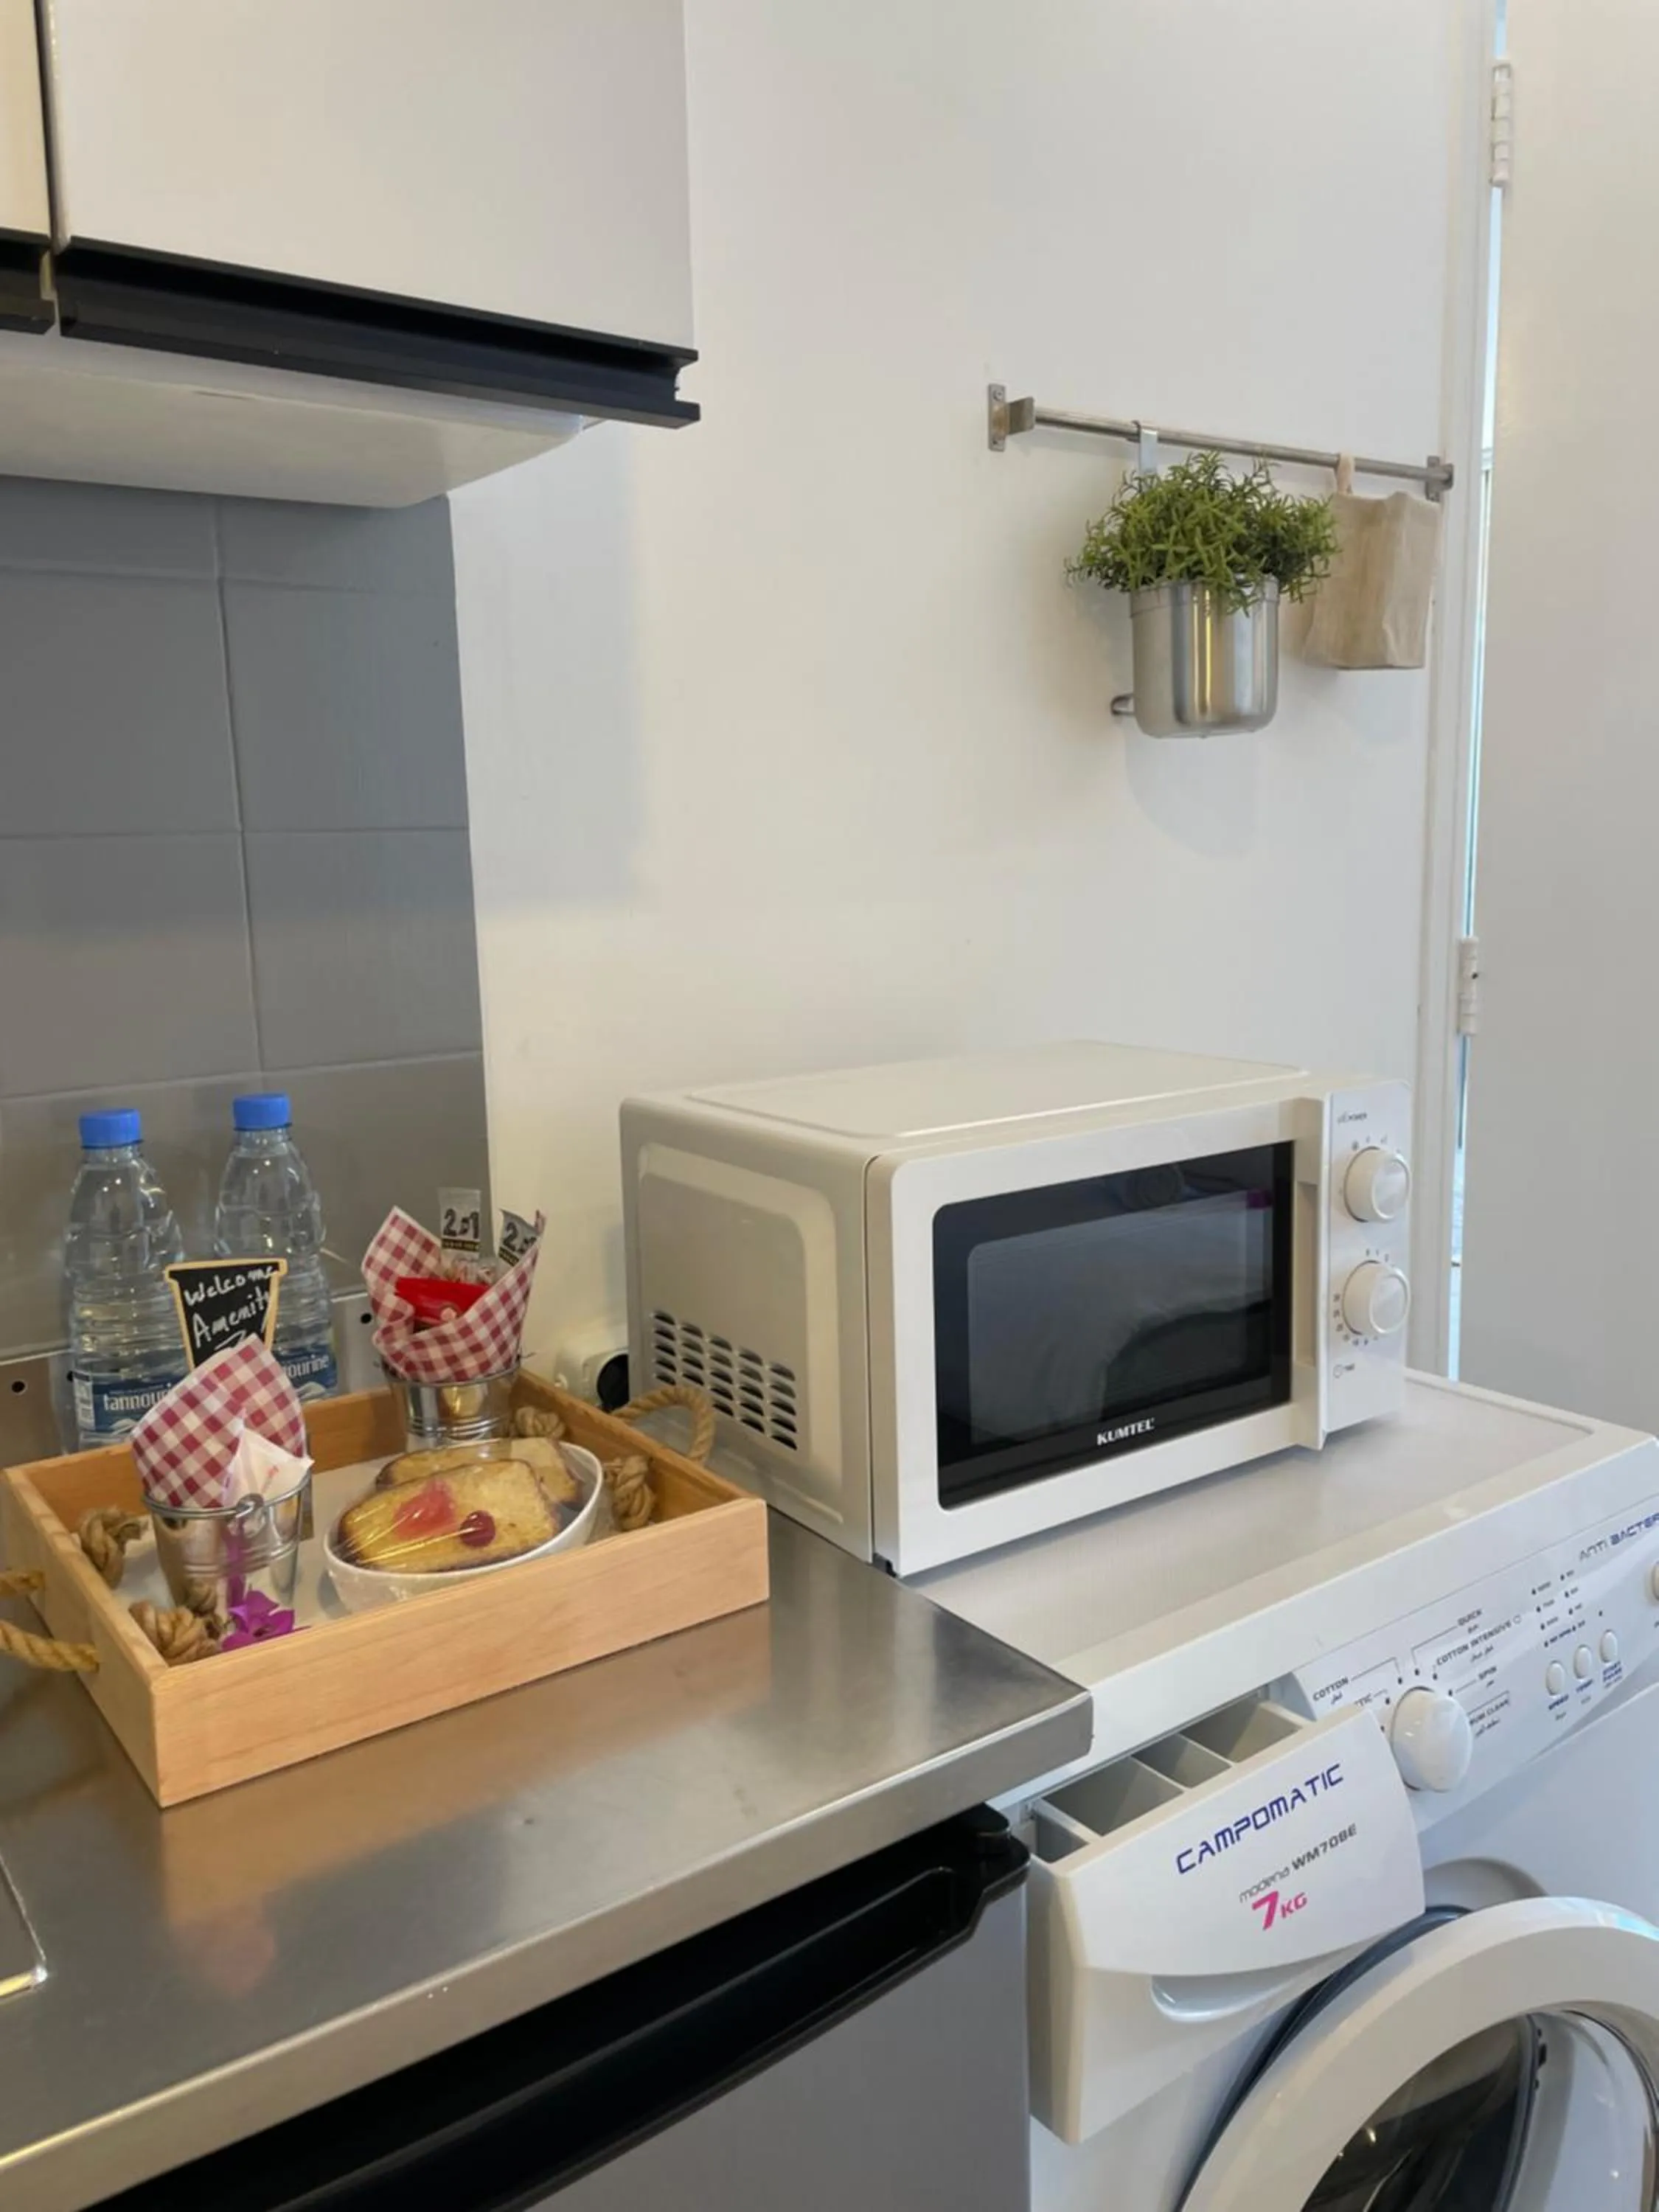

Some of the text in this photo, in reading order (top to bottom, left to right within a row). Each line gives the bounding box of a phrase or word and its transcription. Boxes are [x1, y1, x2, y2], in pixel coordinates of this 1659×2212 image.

[184, 1266, 277, 1306] Welcome
[282, 1354, 330, 1378] ourine
[1096, 1417, 1155, 1445] KUMTEL
[1312, 1677, 1349, 1701] COTTON
[1176, 1763, 1343, 1874] CAMPOMATIC
